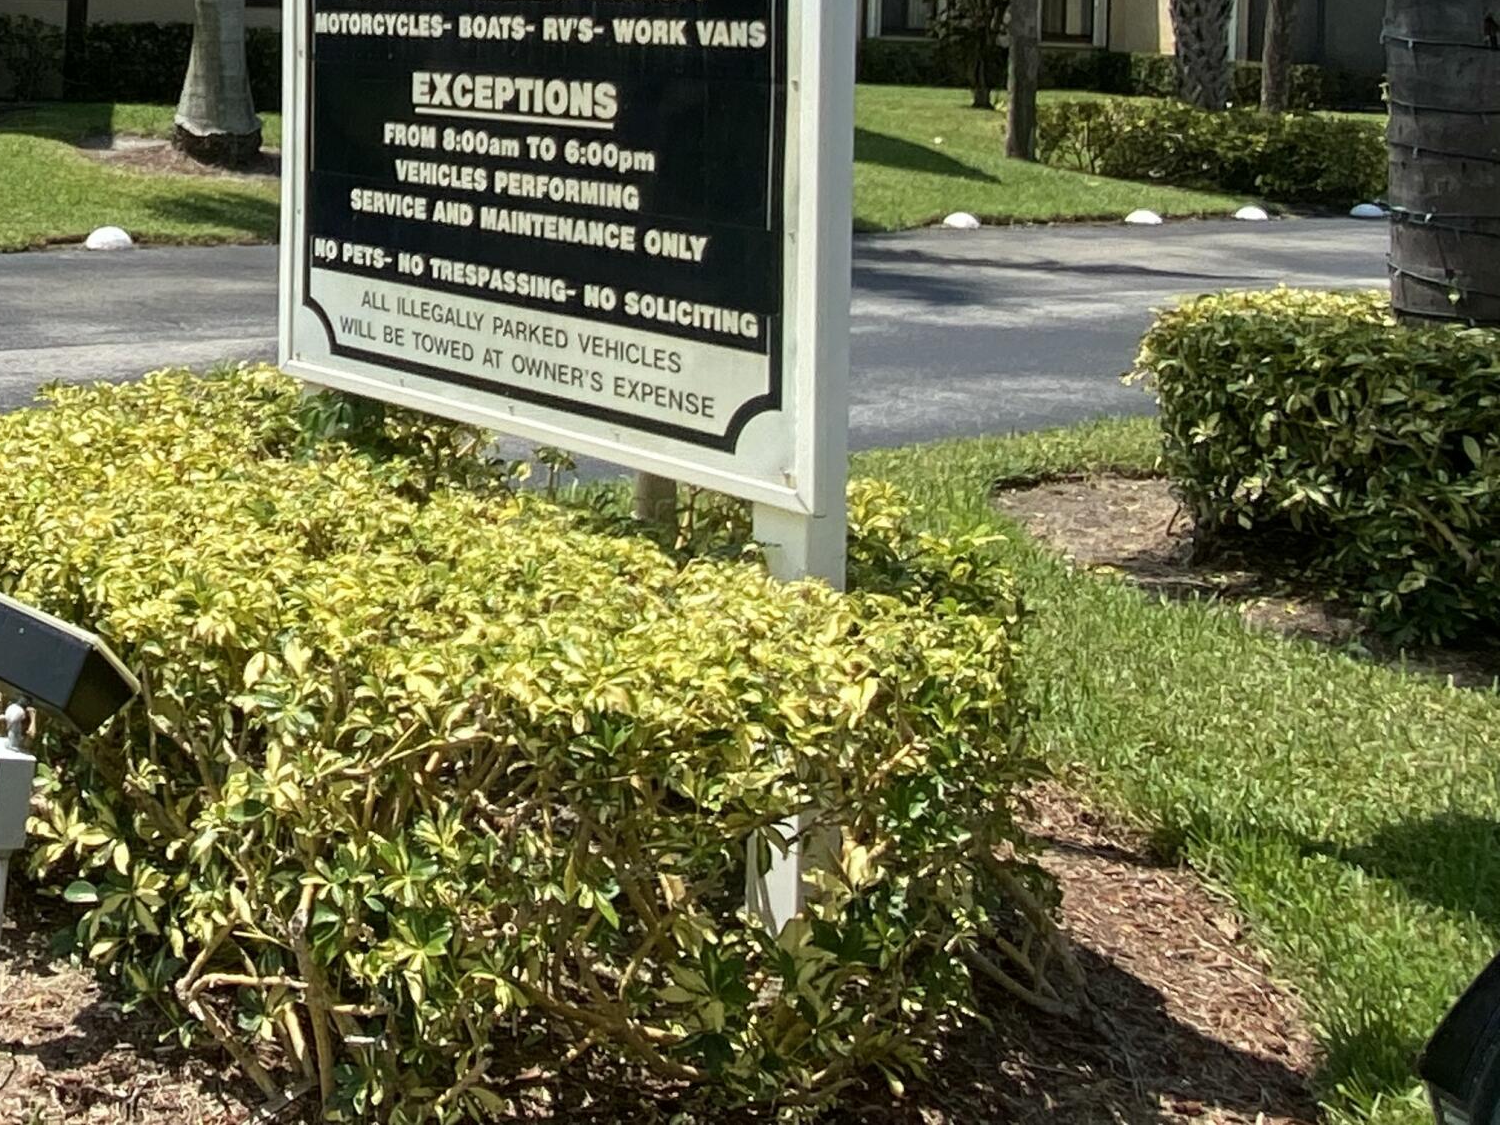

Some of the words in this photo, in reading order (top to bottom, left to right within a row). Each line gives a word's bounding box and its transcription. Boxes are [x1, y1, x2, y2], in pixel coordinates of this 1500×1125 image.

[612, 18, 687, 45] WORK
[696, 20, 767, 47] VANS
[412, 71, 618, 119] EXCEPTIONS
[384, 123, 436, 148] FROM
[442, 128, 520, 157] 8:00am
[526, 136, 556, 161] TO
[564, 139, 655, 173] 6:00pm
[395, 159, 488, 192] VEHICLES
[494, 171, 639, 211] PERFORMING
[350, 188, 427, 220] SERVICE
[432, 200, 473, 226] AND
[480, 206, 636, 251] MAINTENANCE
[644, 228, 709, 261] ONLY
[315, 238, 337, 259] NO
[398, 253, 424, 276] NO
[584, 284, 616, 311] NO
[624, 291, 759, 338] SOLICITING
[361, 290, 390, 312] ALL
[397, 296, 485, 332] ILLEGALLY
[492, 317, 568, 349] PARKED
[578, 333, 682, 374] VEHICLES
[340, 315, 376, 340] WILL
[383, 325, 405, 346] BE
[412, 332, 474, 362] TOWED
[483, 348, 503, 369] AT
[512, 354, 603, 392] OWNER'S
[614, 376, 715, 418] EXPENSE
